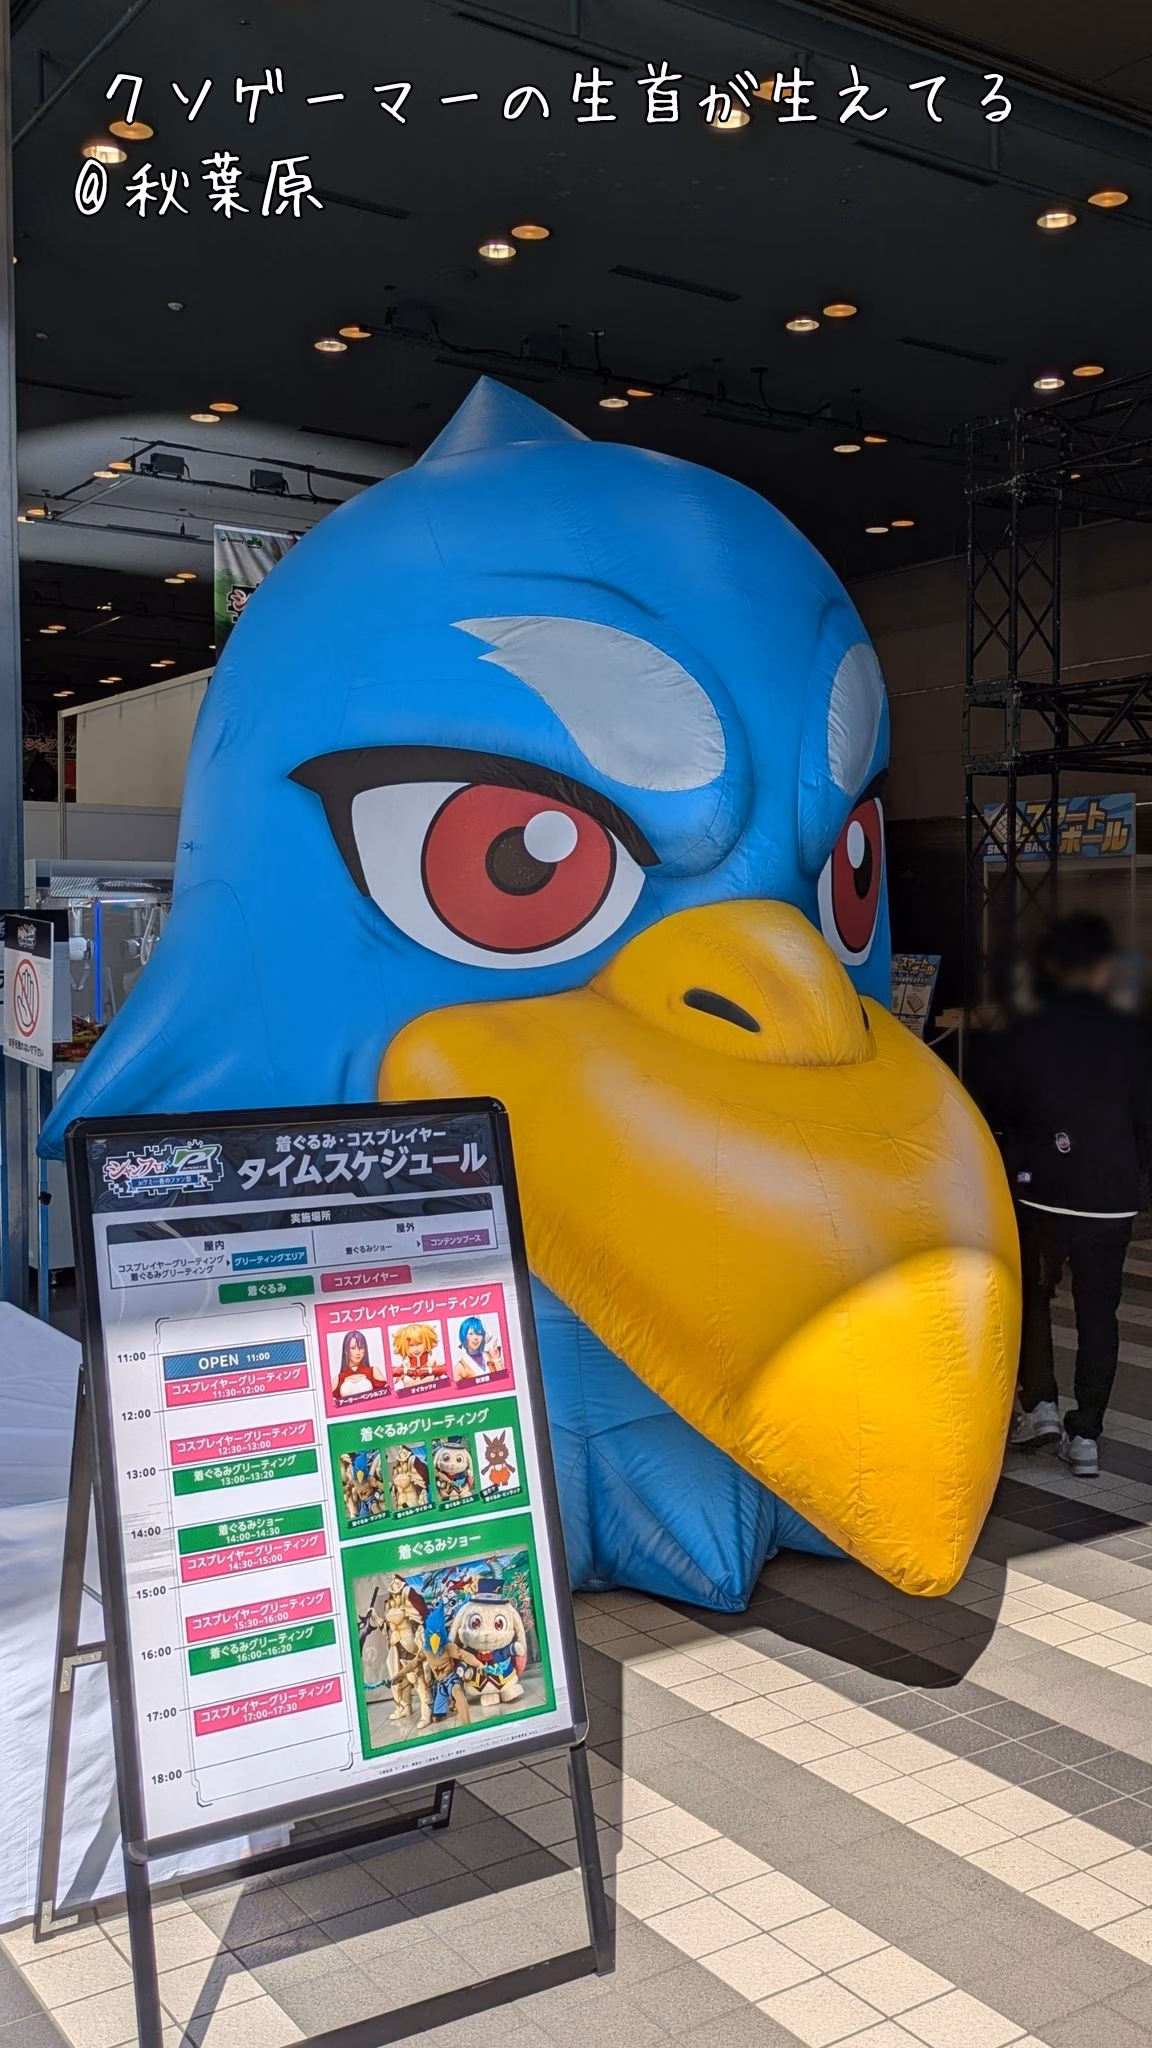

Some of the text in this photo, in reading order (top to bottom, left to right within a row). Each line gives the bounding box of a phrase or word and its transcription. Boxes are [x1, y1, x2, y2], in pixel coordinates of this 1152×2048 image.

[1058, 820, 1129, 854] ボール
[276, 1128, 447, 1152] 着ぐるみ・コスプレイヤー
[237, 1142, 487, 1190] タイムスケジュール
[291, 1210, 331, 1224] 実施場所
[396, 1222, 415, 1233] 屋外
[204, 1240, 225, 1252] 屋内
[430, 1234, 482, 1246] コンテンツブース
[345, 1244, 393, 1256] 着ぐるみショー
[118, 1254, 225, 1273] コスプレイヤーグリーティング
[234, 1251, 305, 1267] グリーティングエリア
[130, 1265, 215, 1282] 着ぐるみグリーティング
[334, 1271, 399, 1287] コスプレイヤー
[248, 1282, 287, 1297] 着ぐるみ
[329, 1291, 492, 1325] コスプレイヤーグリーティング
[117, 1352, 146, 1363] 11:00
[199, 1352, 270, 1370] OPEN 11:00
[172, 1369, 301, 1396] コスプレイヤーグリーティング
[122, 1410, 151, 1422] 12:00
[360, 1407, 490, 1442] 着ぐるみグリーティング
[177, 1423, 307, 1453] コスプレイヤーグリーティング
[126, 1467, 156, 1480] 13:00
[194, 1455, 296, 1482] 着ぐるみグリーティング
[131, 1526, 161, 1539] 14:00
[218, 1516, 284, 1537] 着ぐるみショー
[187, 1535, 318, 1570] コスプレイヤーグリーティング
[398, 1534, 482, 1561] 着ぐるみショー
[136, 1586, 166, 1600] 15:00
[192, 1592, 324, 1630] コスプレイヤーグリーティング
[210, 1626, 314, 1659] 着ぐるみグリーティング
[141, 1646, 171, 1660] 16:00
[201, 1682, 334, 1722] コスプレイヤーグリーティング
[147, 1707, 177, 1722] 17:00
[151, 1769, 182, 1785] 18:00
